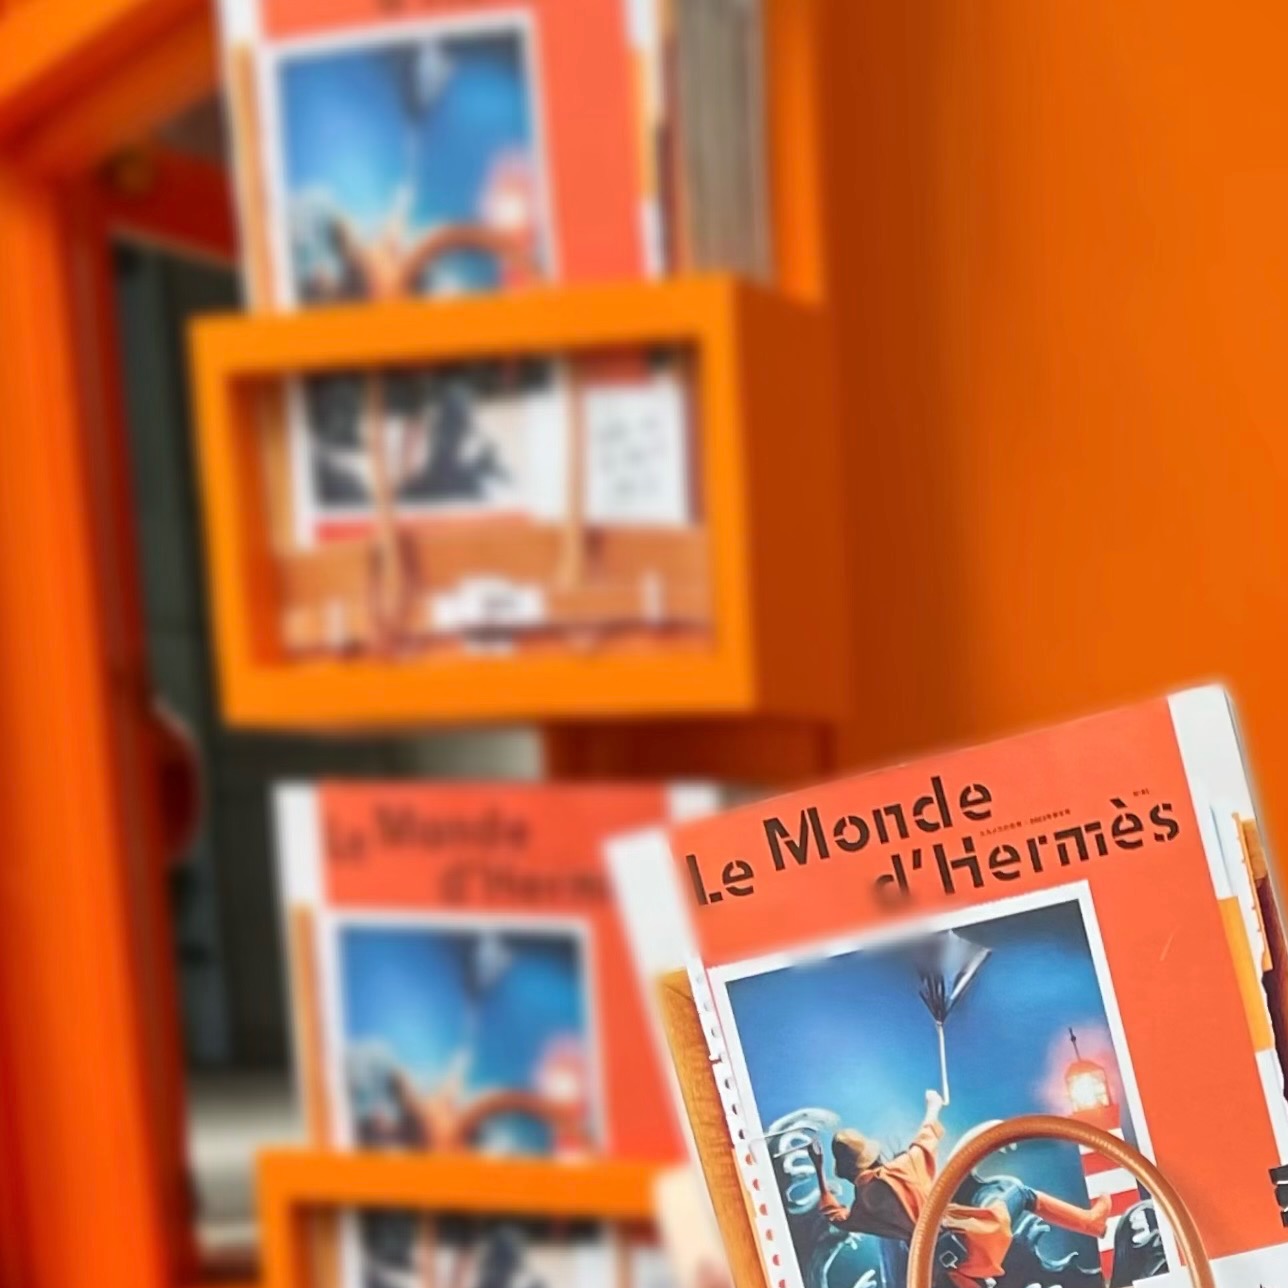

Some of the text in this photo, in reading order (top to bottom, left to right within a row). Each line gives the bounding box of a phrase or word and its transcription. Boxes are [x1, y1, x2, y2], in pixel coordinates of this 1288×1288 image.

[685, 775, 993, 906] Le Monde
[872, 796, 1181, 906] d'Hermès
